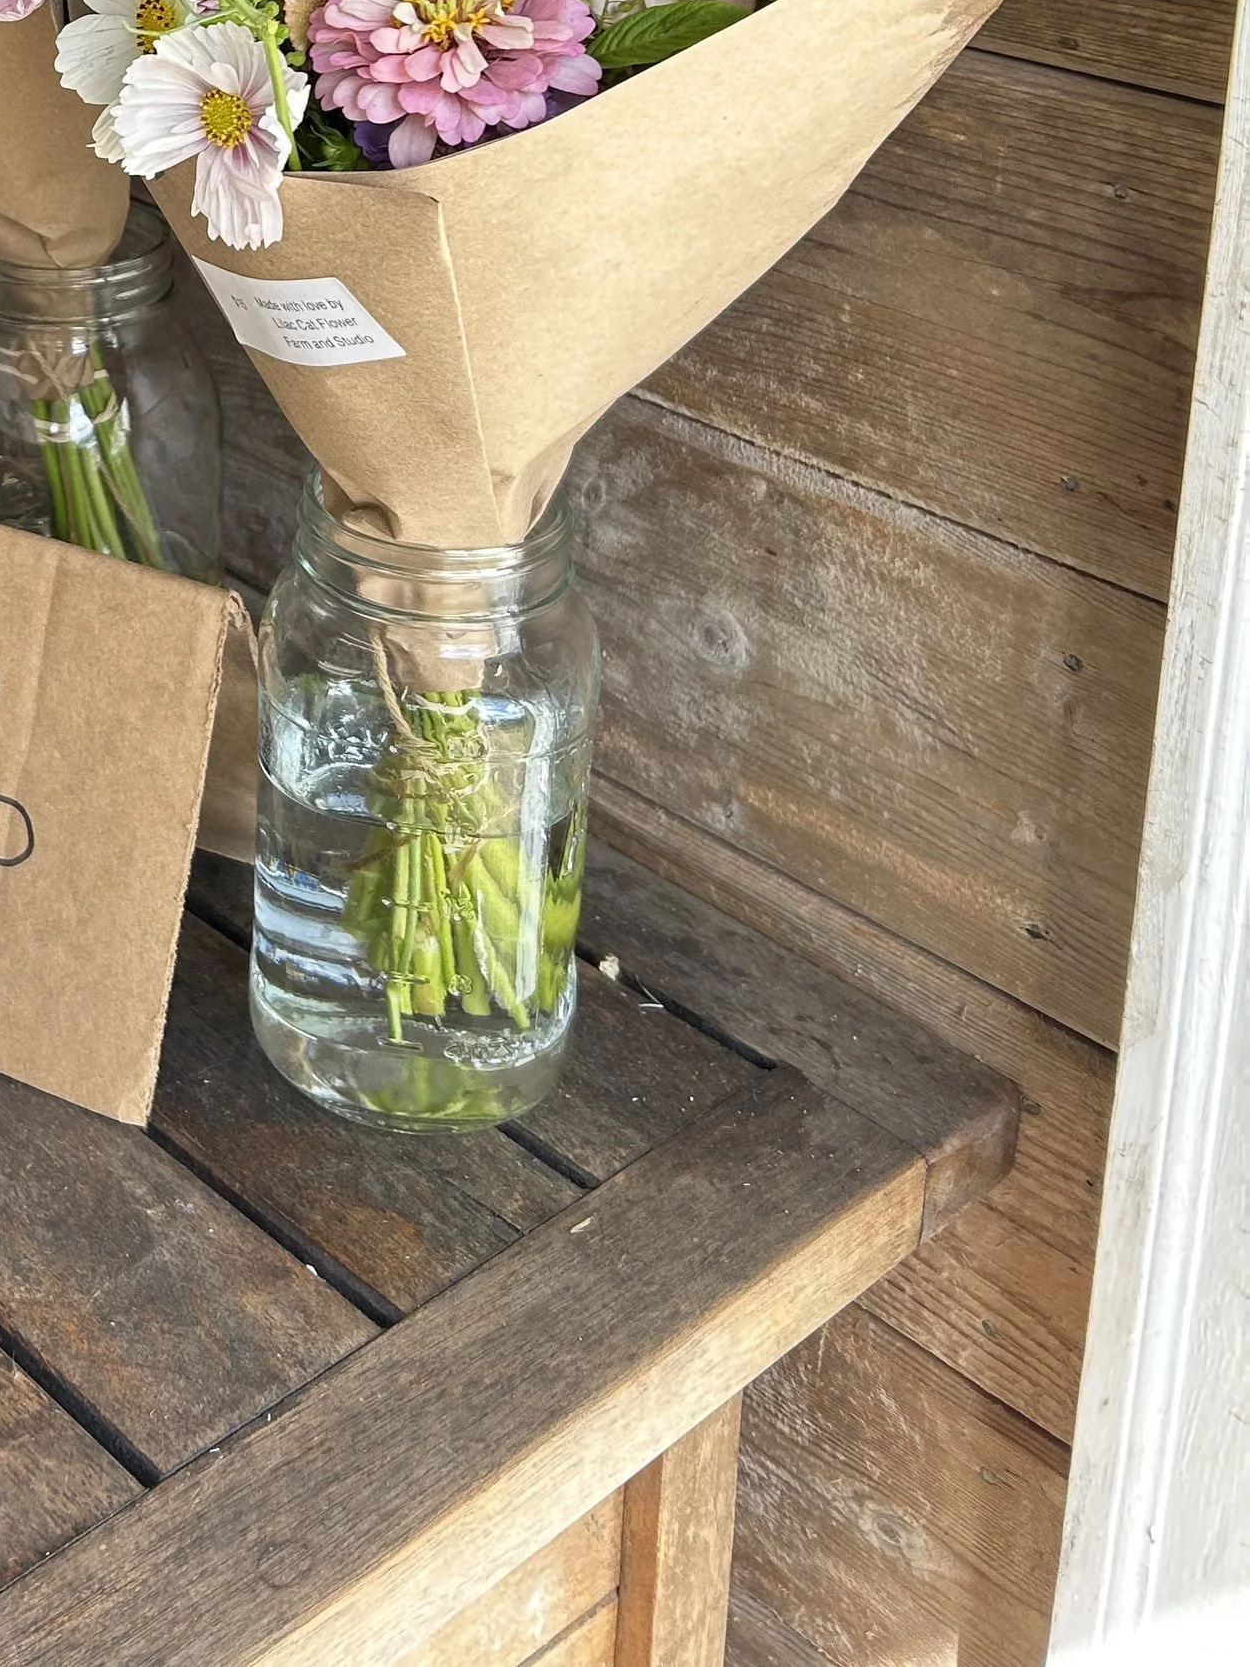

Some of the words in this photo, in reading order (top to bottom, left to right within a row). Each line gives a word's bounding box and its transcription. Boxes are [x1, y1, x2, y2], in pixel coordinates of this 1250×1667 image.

[254, 295, 282, 311] Made
[281, 300, 304, 313] with
[303, 297, 327, 312] love
[325, 296, 345, 312] by
[271, 316, 298, 331] Lilac
[297, 317, 320, 332] Cat
[319, 315, 359, 331] Flower
[283, 335, 313, 350] Farm
[314, 337, 335, 350] and
[333, 333, 376, 347] Studio
